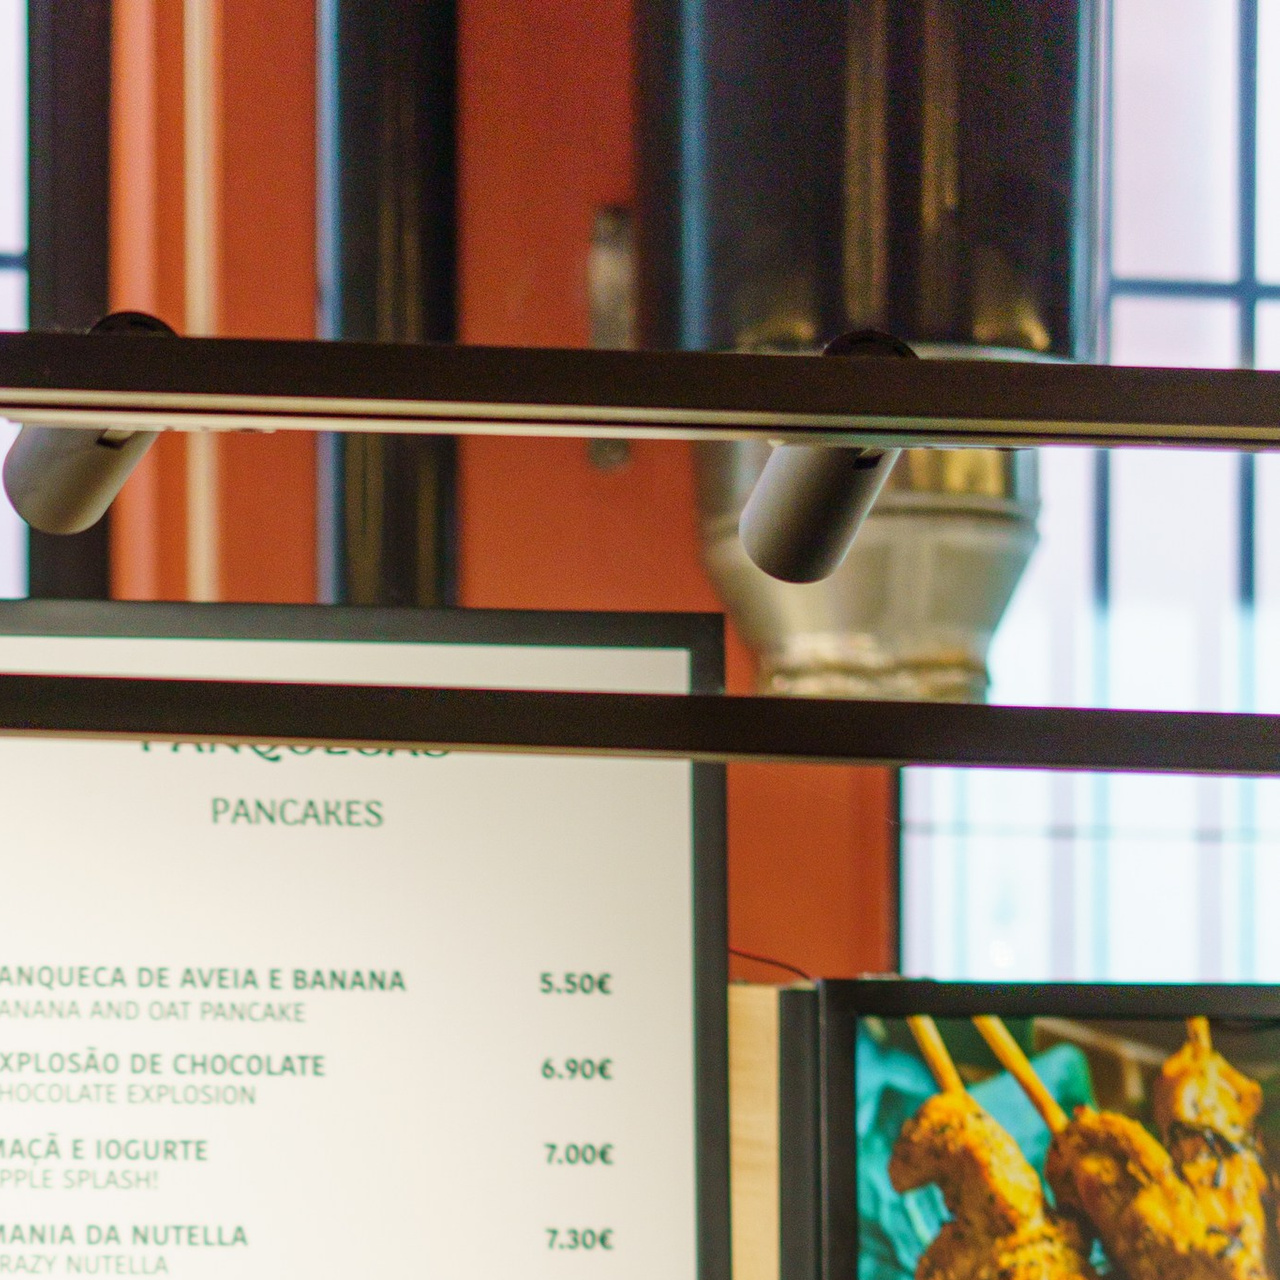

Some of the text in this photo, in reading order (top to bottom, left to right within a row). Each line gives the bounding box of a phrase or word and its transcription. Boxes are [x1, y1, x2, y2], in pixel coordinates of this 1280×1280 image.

[212, 798, 384, 827] PANCAKES
[137, 967, 169, 988] DE
[180, 967, 259, 989] AVEIA
[269, 968, 282, 990] E
[293, 969, 406, 991] BANANA
[541, 972, 611, 995] 5.50€
[90, 1000, 140, 1021] AND
[148, 1000, 192, 1021] OAT
[200, 1001, 305, 1023] PANCAKE
[130, 1053, 162, 1075] DE
[173, 1053, 325, 1077] CHOCOLATE
[541, 1058, 612, 1080] 6.90€
[127, 1083, 256, 1105] EXPLOSION
[72, 1139, 84, 1160] E
[96, 1139, 207, 1161] IOGURTE
[545, 1143, 613, 1165] 7.00€
[63, 1169, 158, 1190] SPLASH!
[86, 1224, 121, 1245] DA
[132, 1225, 248, 1246] NUTELLA
[546, 1228, 613, 1250] 7.30€
[66, 1254, 169, 1275] NUTELLA
